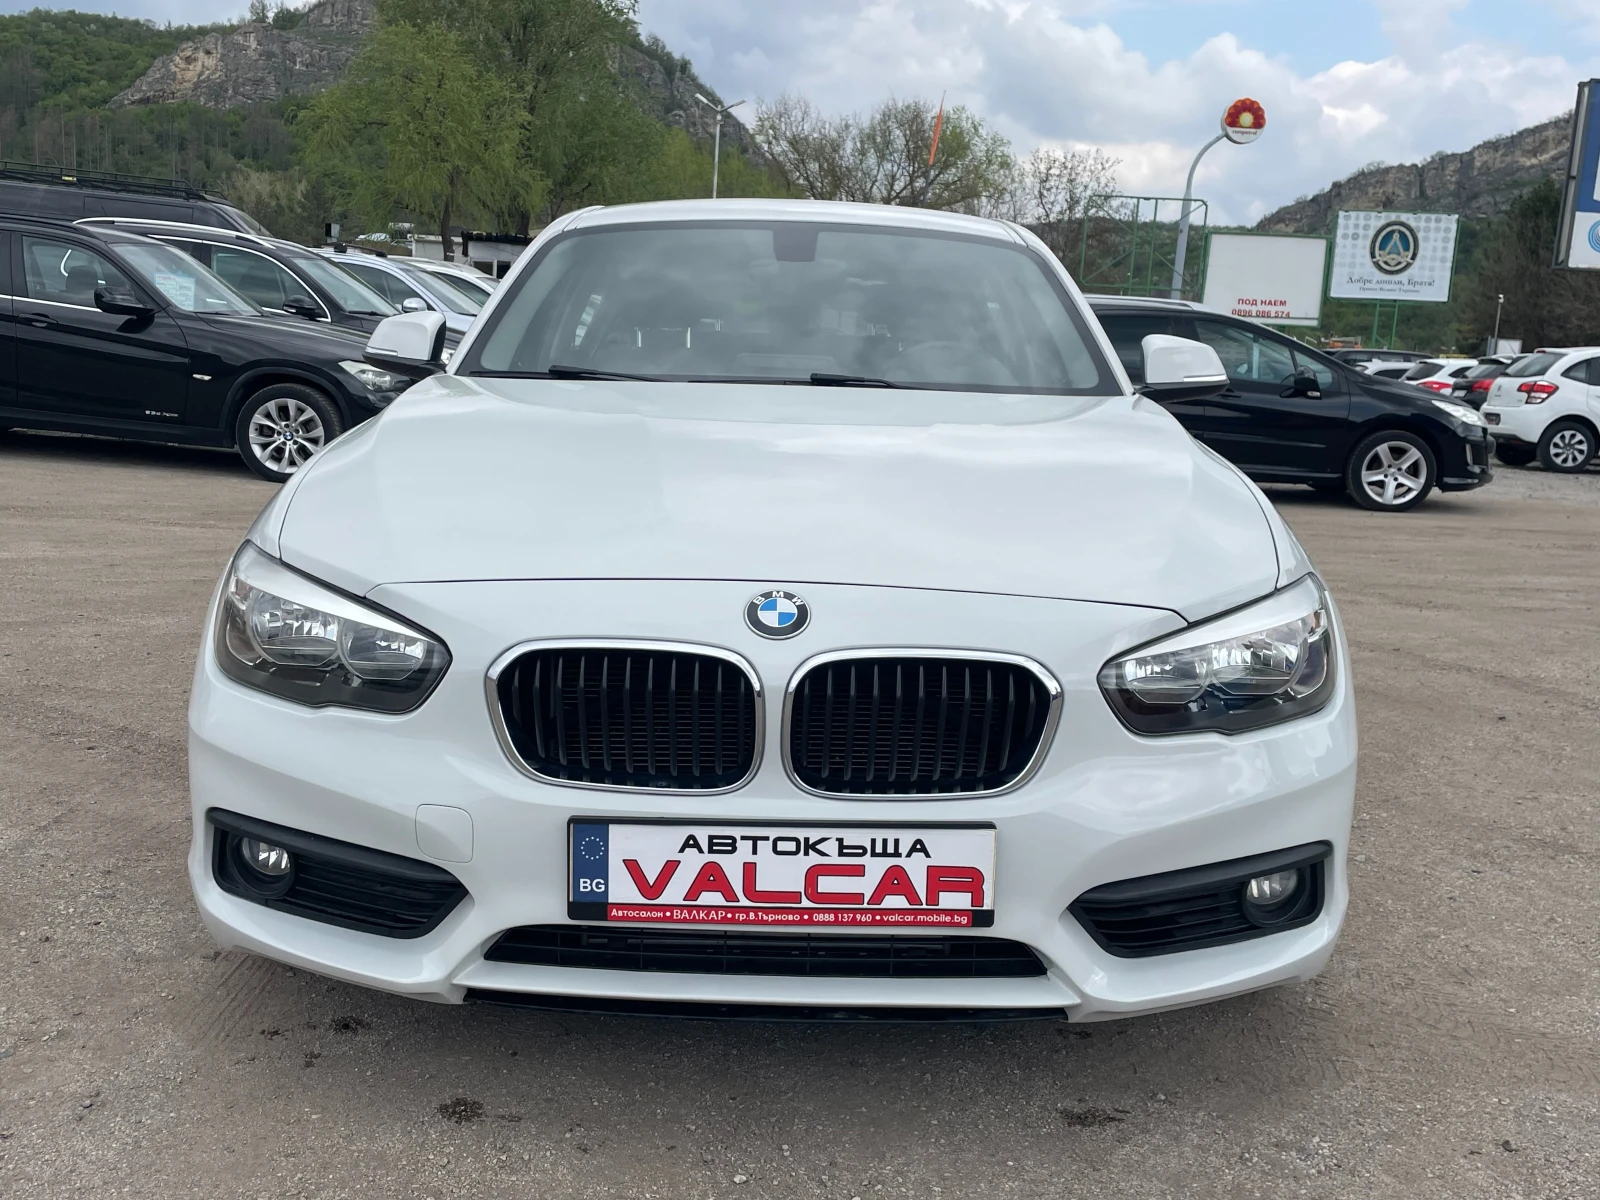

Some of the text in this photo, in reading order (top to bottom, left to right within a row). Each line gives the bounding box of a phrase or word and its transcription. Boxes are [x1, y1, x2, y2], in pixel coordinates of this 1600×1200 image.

[1346, 276, 1373, 286] Добре
[1237, 298, 1287, 307] ПОД НАЕМ
[1231, 308, 1291, 318] 0896 086 574
[752, 591, 804, 606] BMW
[678, 834, 932, 858] АВТОКЪЩА
[579, 878, 606, 892] BG
[622, 859, 985, 908] VALCAR
[611, 908, 664, 918] Автосалон
[673, 909, 726, 920] ВАЛКАР
[812, 913, 835, 922] 0888
[838, 913, 853, 922] 137
[855, 914, 873, 923] 960
[882, 913, 968, 924] valcar.mobile.bg
